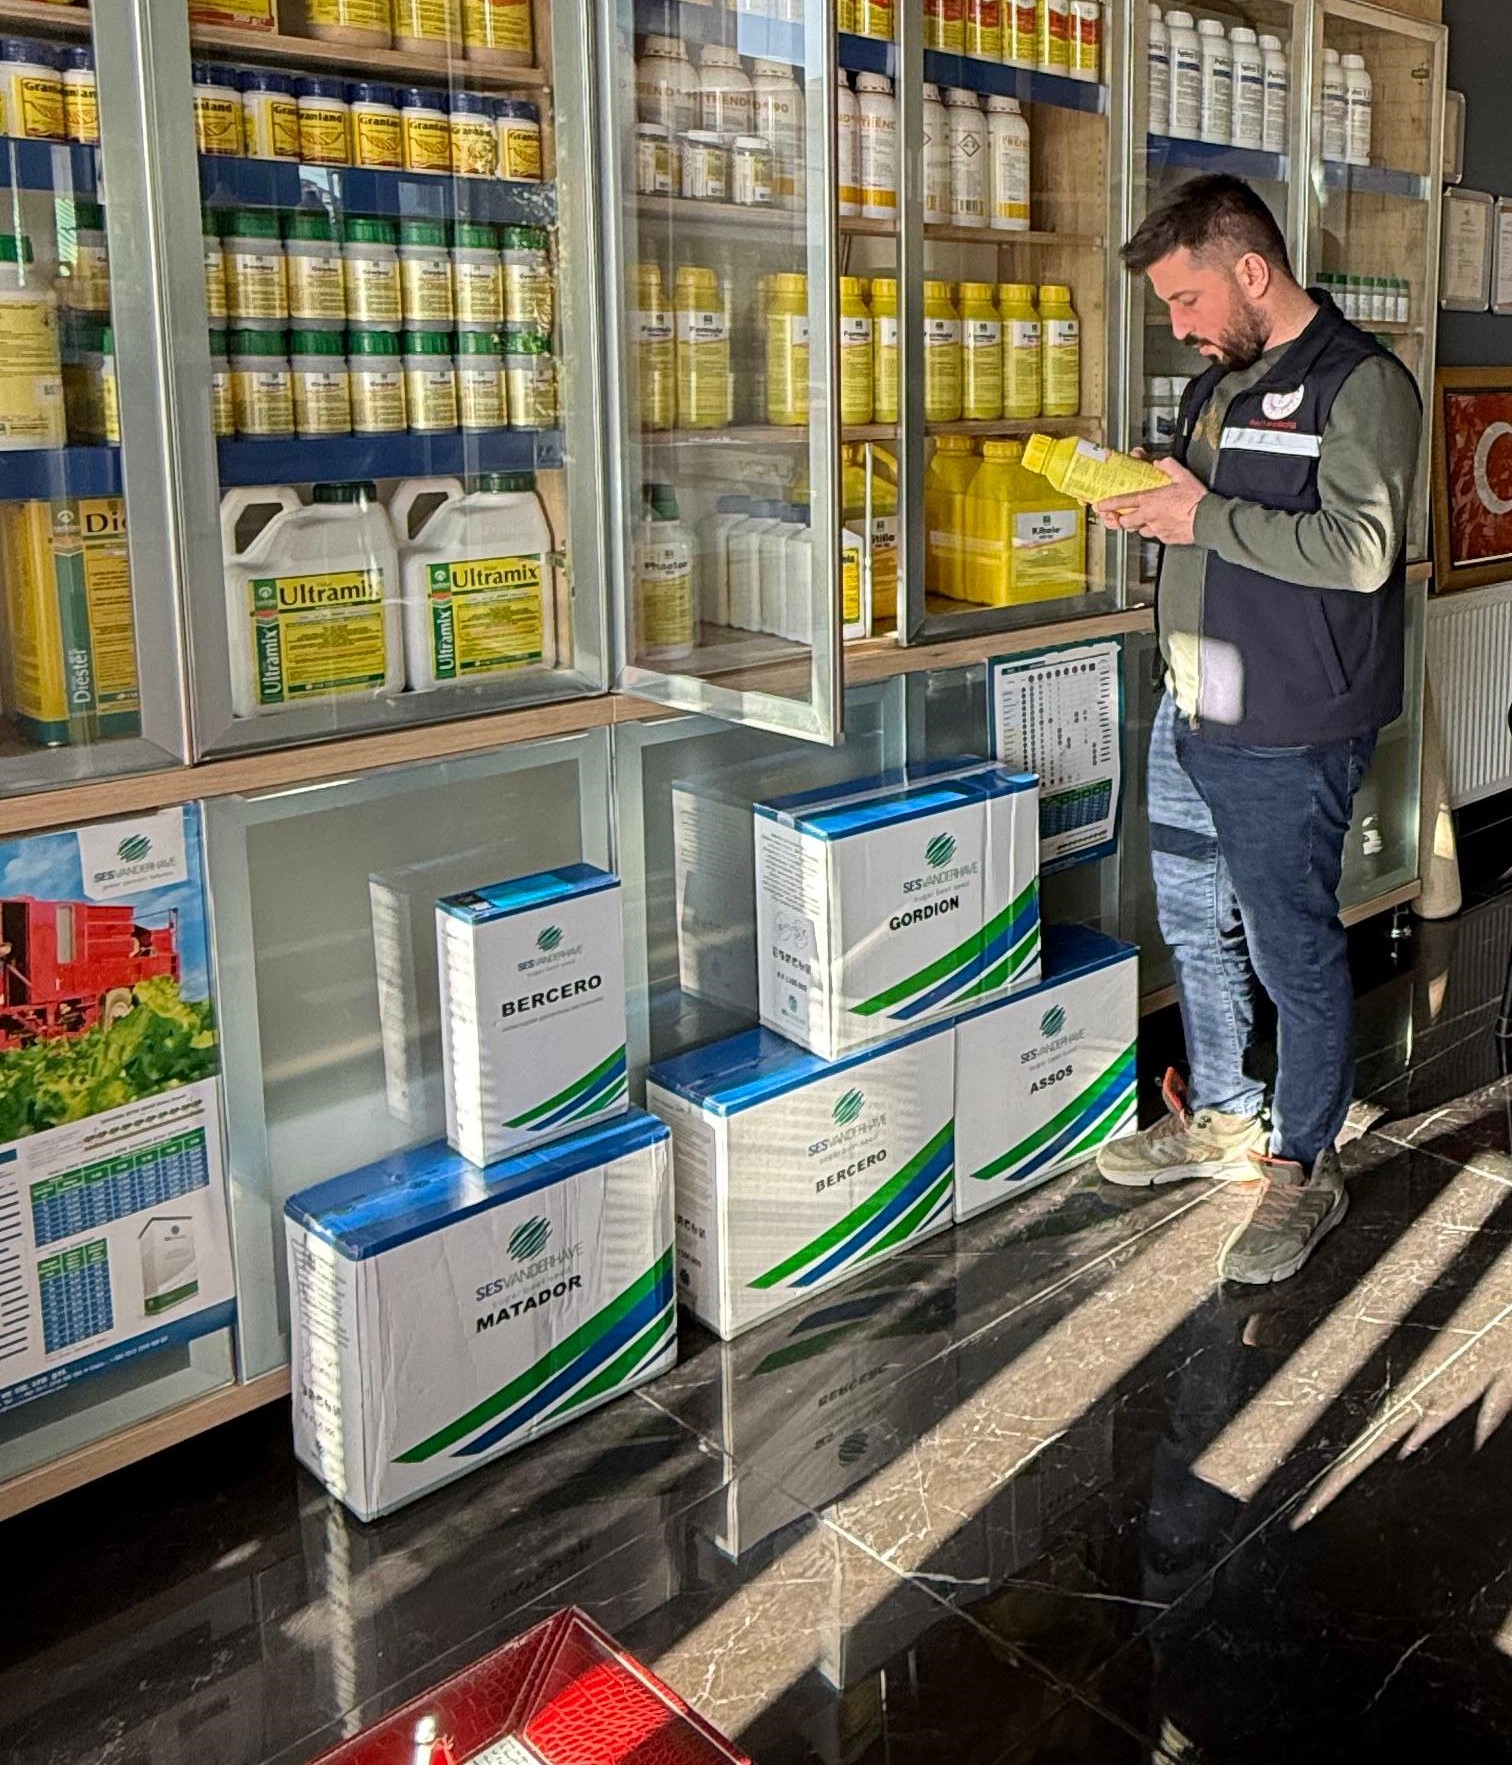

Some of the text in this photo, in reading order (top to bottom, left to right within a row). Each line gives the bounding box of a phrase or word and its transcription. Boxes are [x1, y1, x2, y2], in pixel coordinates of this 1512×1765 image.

[452, 564, 538, 588] Ultramix
[261, 628, 282, 695] Ultramix
[438, 609, 456, 670] Ultramix
[889, 895, 959, 931] GORDION
[501, 974, 602, 1018] BERCERO
[1030, 1064, 1073, 1095] ASSOS
[816, 1148, 887, 1193] BERCERO
[476, 1274, 583, 1334] MATADOR
